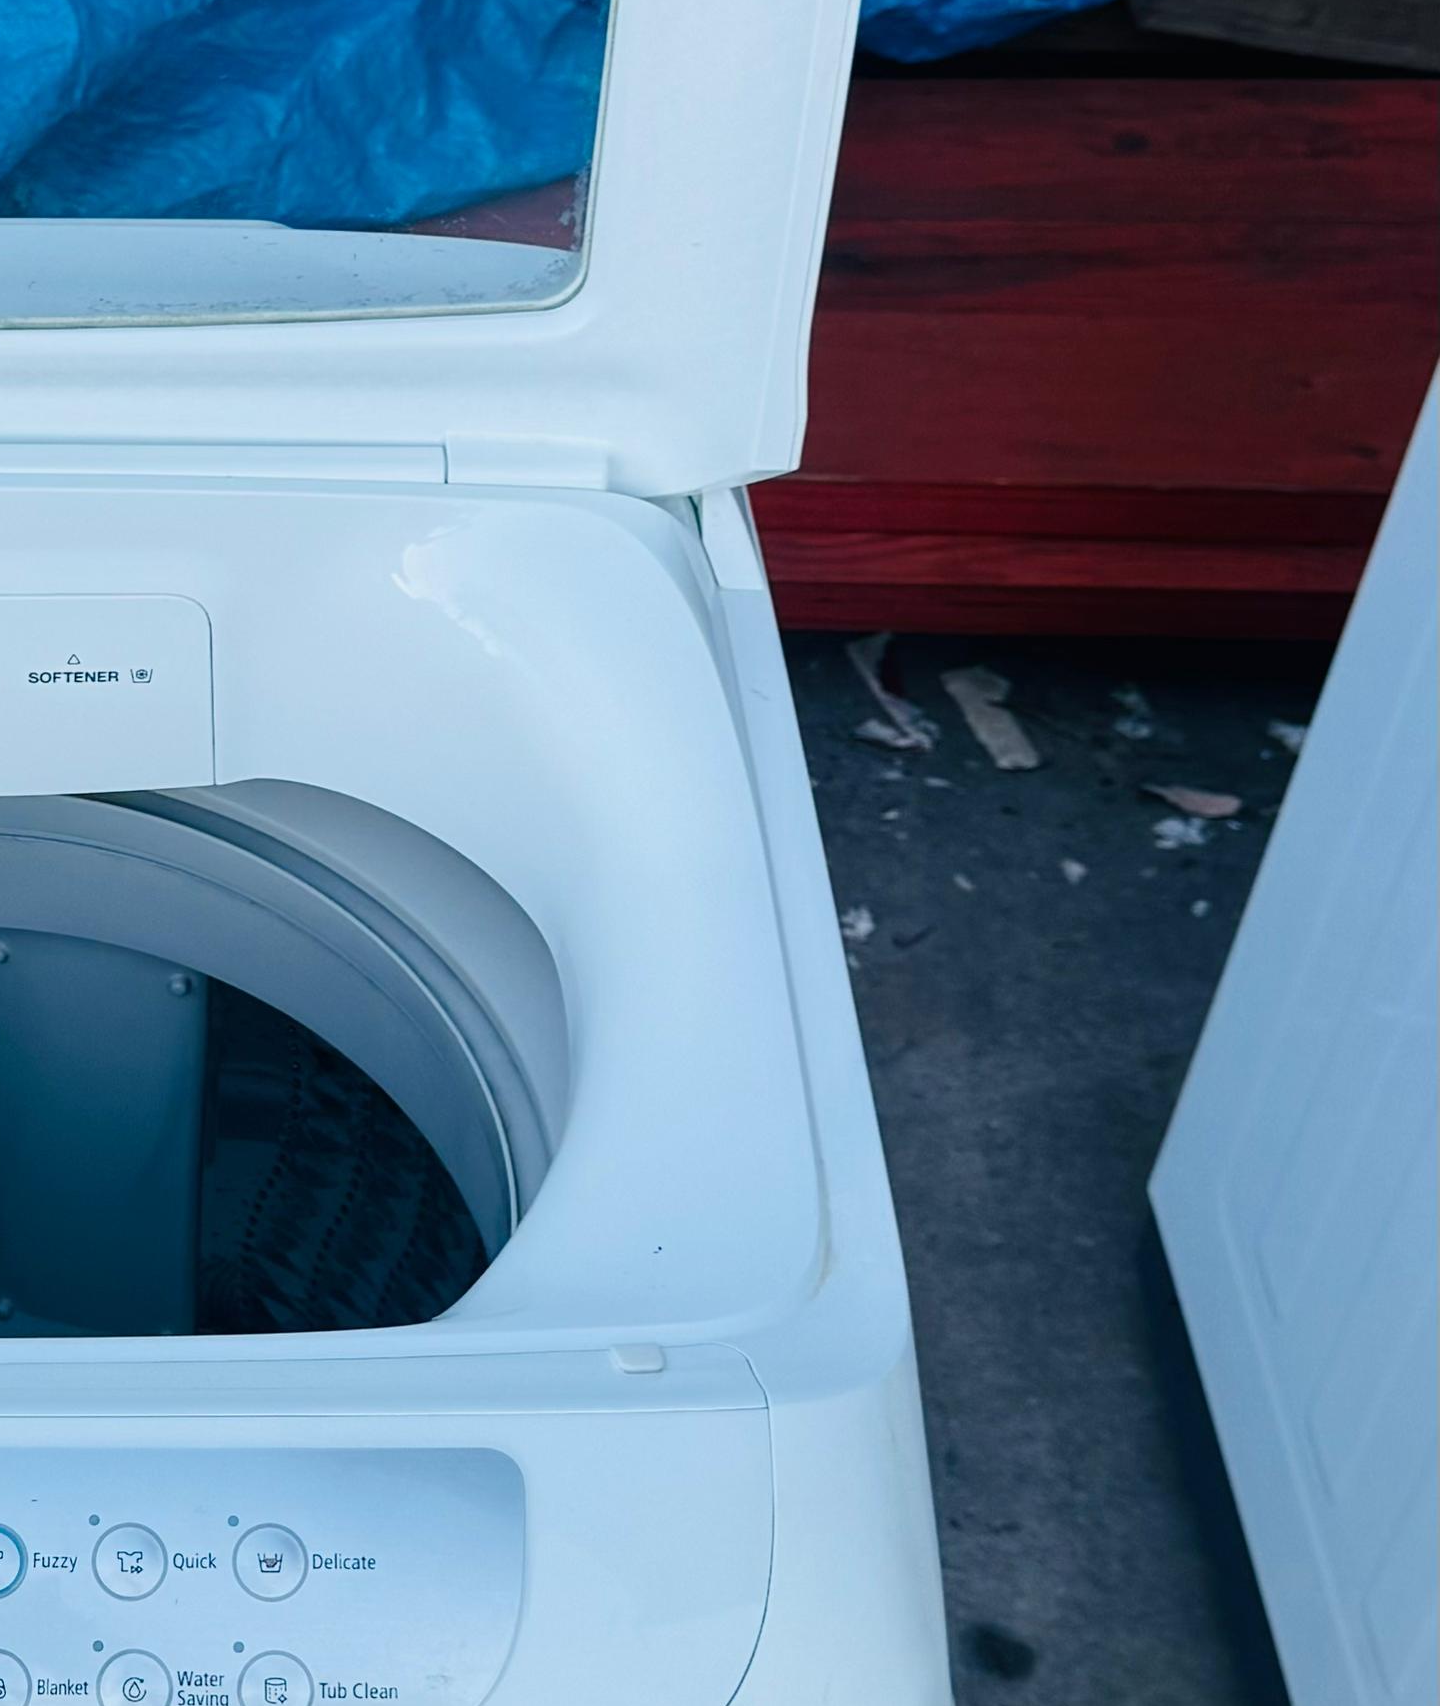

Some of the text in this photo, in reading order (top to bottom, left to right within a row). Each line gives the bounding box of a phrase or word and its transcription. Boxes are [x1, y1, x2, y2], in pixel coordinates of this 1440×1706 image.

[27, 670, 119, 684] SOFTENER
[33, 1551, 78, 1573] Fuzzy
[172, 1552, 217, 1572] Quick
[312, 1552, 377, 1571] Delicate
[37, 1678, 89, 1696] Blanket
[176, 1670, 225, 1687] Water
[318, 1681, 399, 1700] Tub Clean
